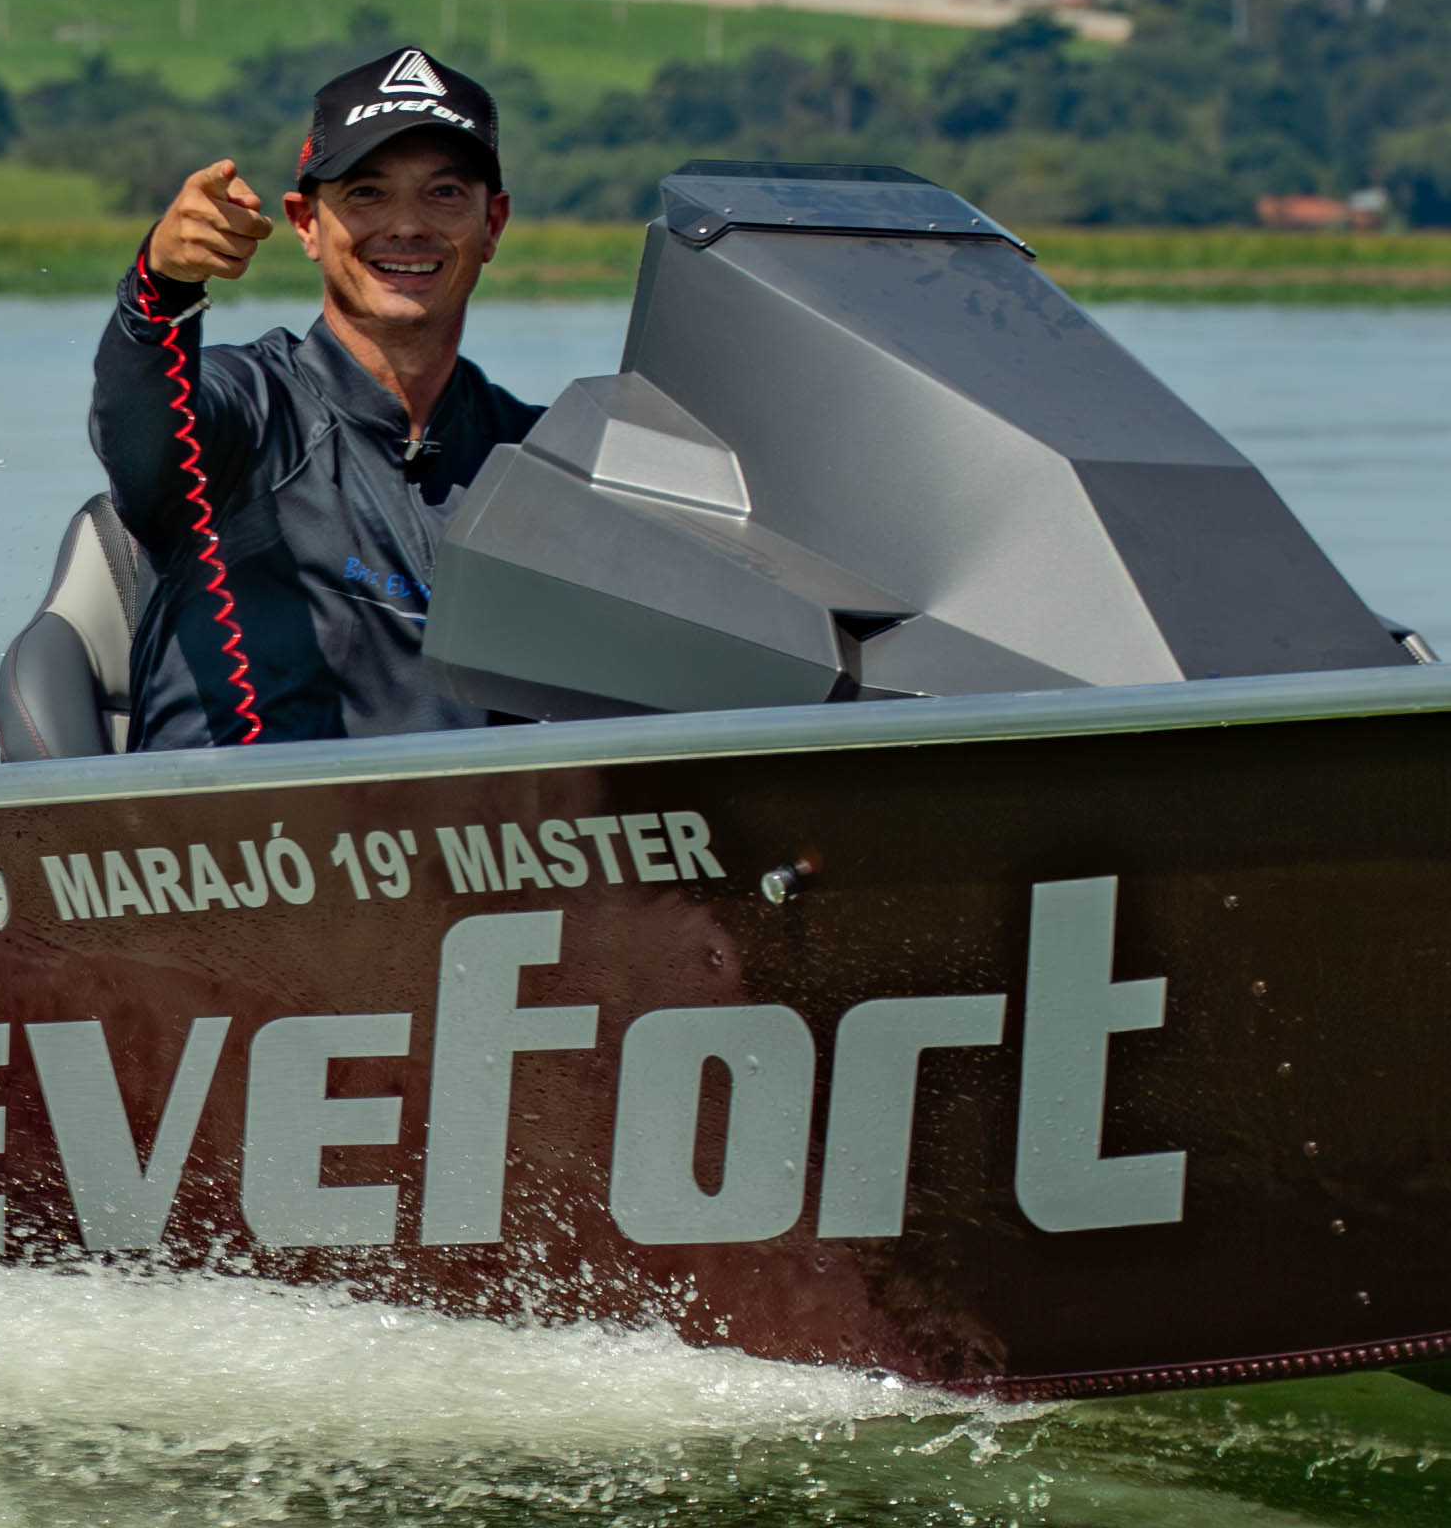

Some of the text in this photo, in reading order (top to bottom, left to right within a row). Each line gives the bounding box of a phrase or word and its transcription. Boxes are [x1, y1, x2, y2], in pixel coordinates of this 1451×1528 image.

[41, 811, 728, 921] MARAJÓ 19' MASTER
